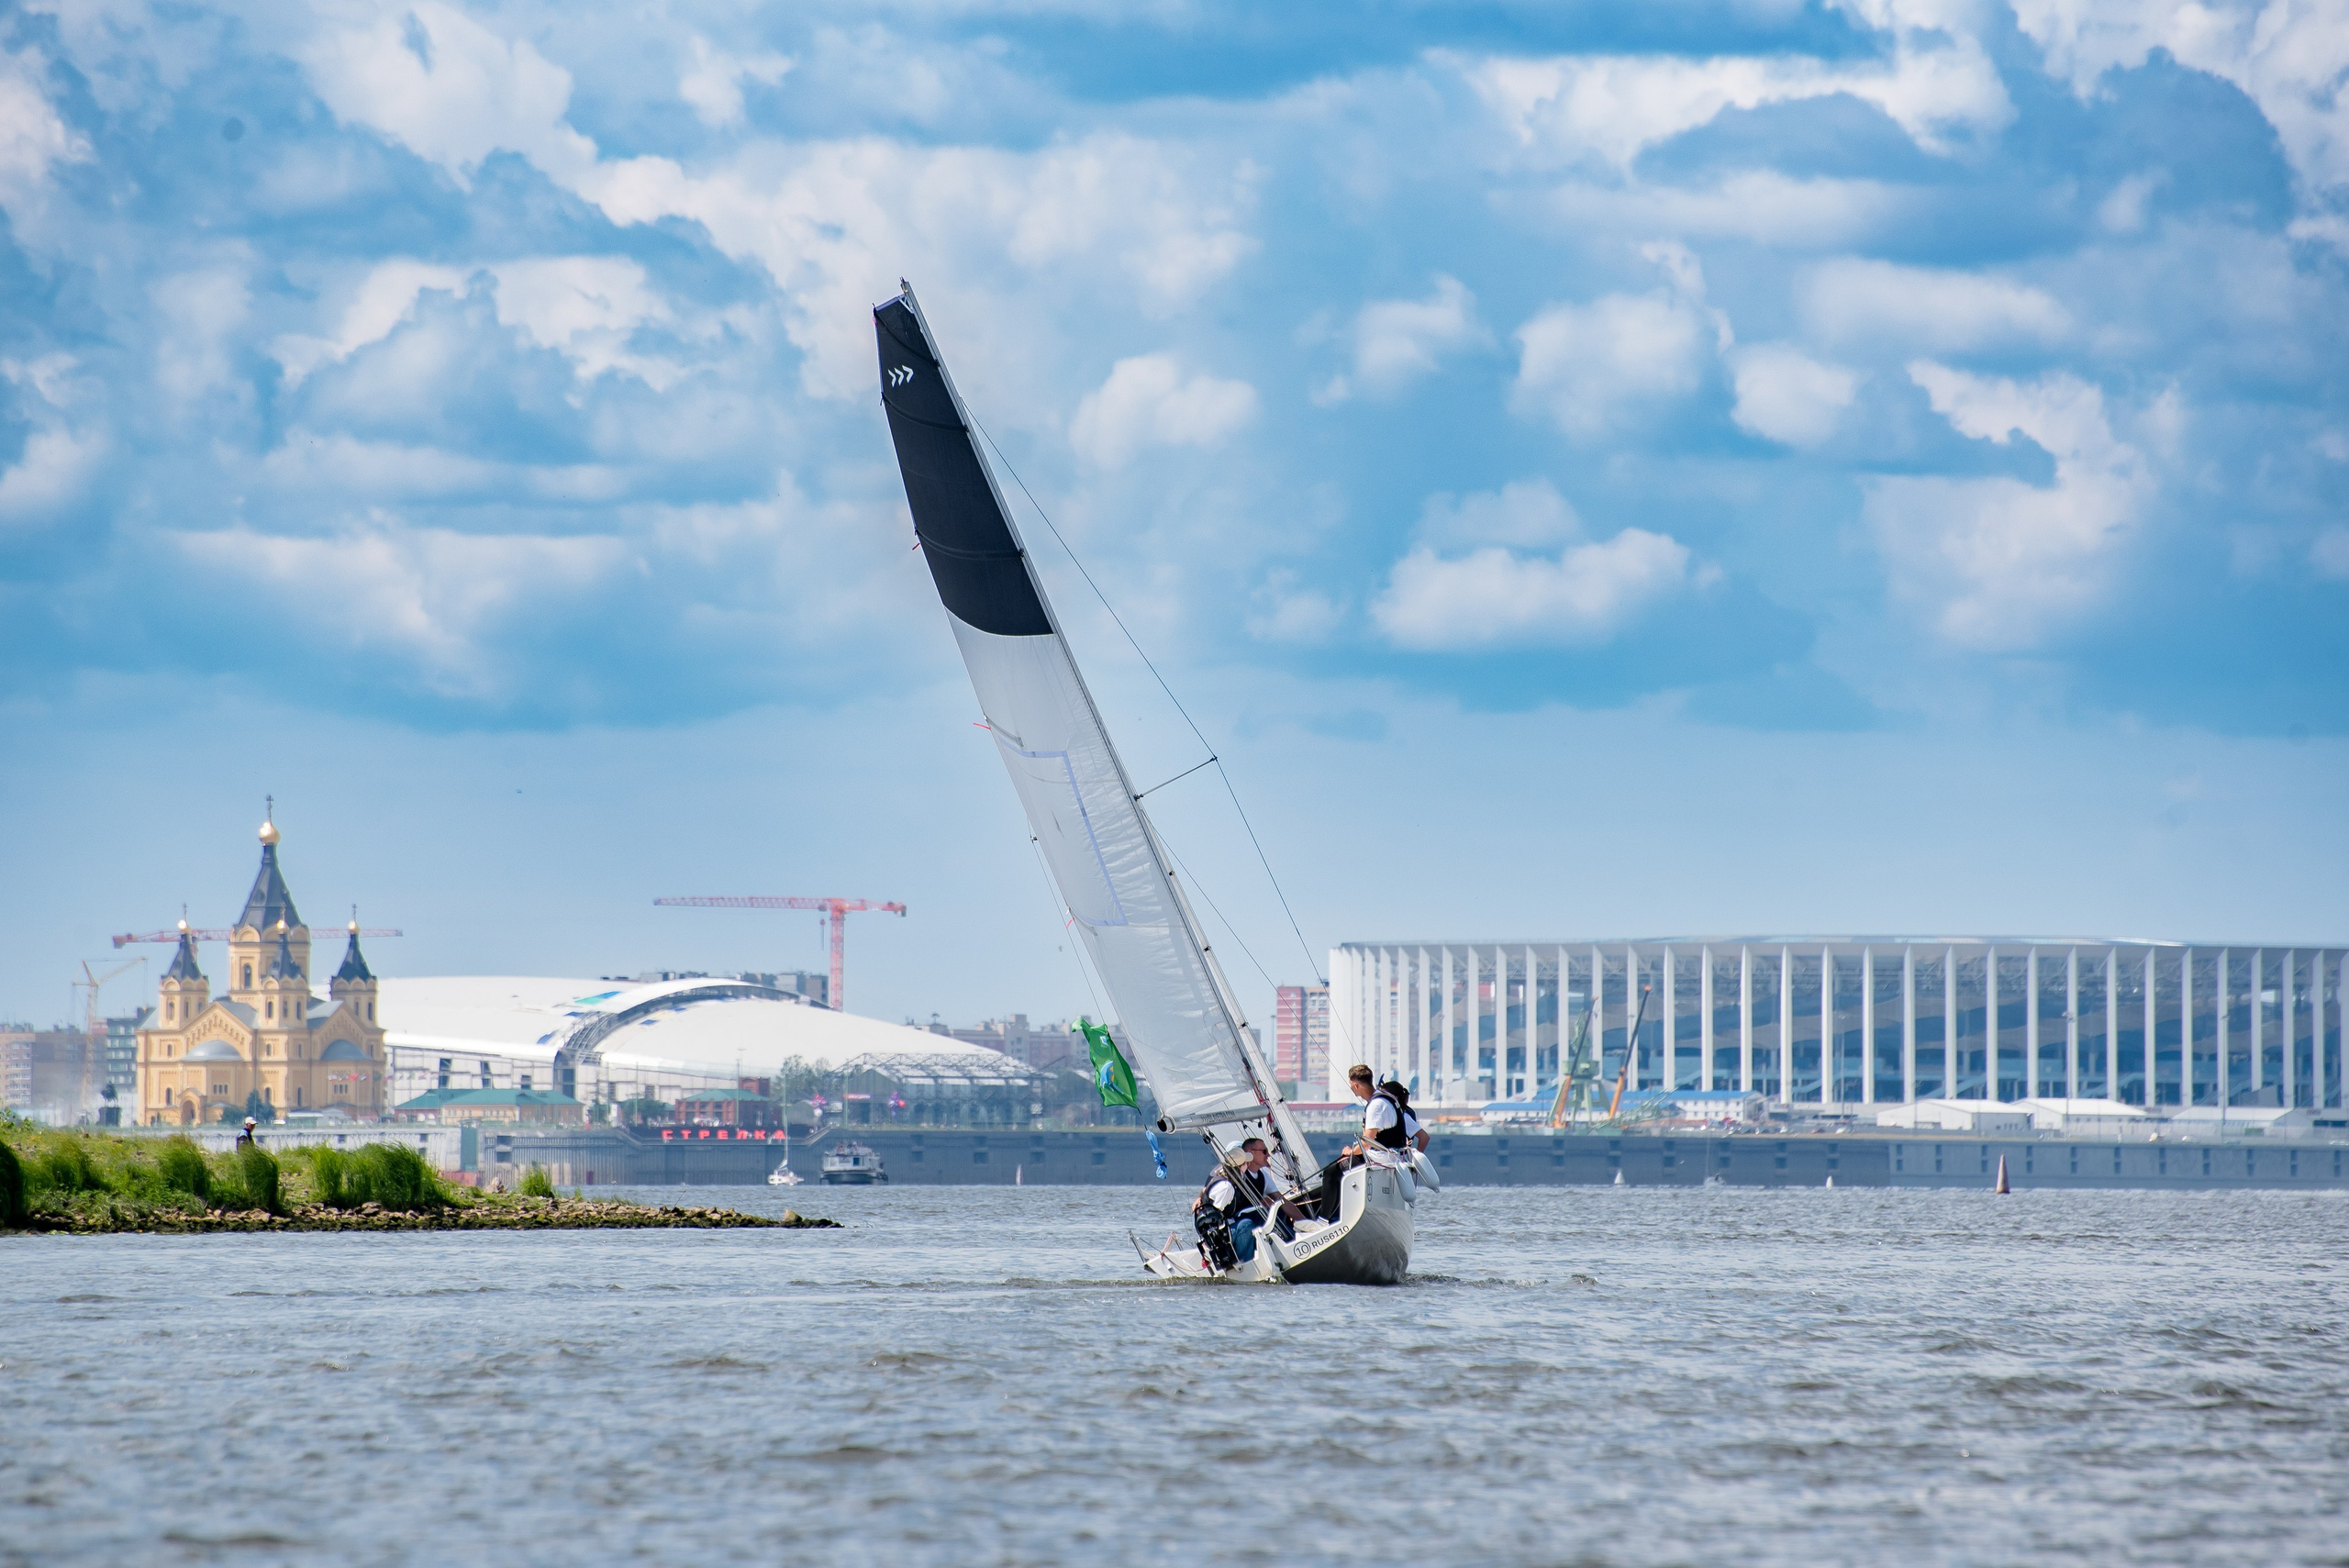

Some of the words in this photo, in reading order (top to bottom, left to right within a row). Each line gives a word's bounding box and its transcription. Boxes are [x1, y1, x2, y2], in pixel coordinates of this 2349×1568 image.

[662, 1129, 787, 1140] СТРЕЛКА
[1295, 1243, 1310, 1258] 10
[1311, 1225, 1351, 1250] RUS6110
